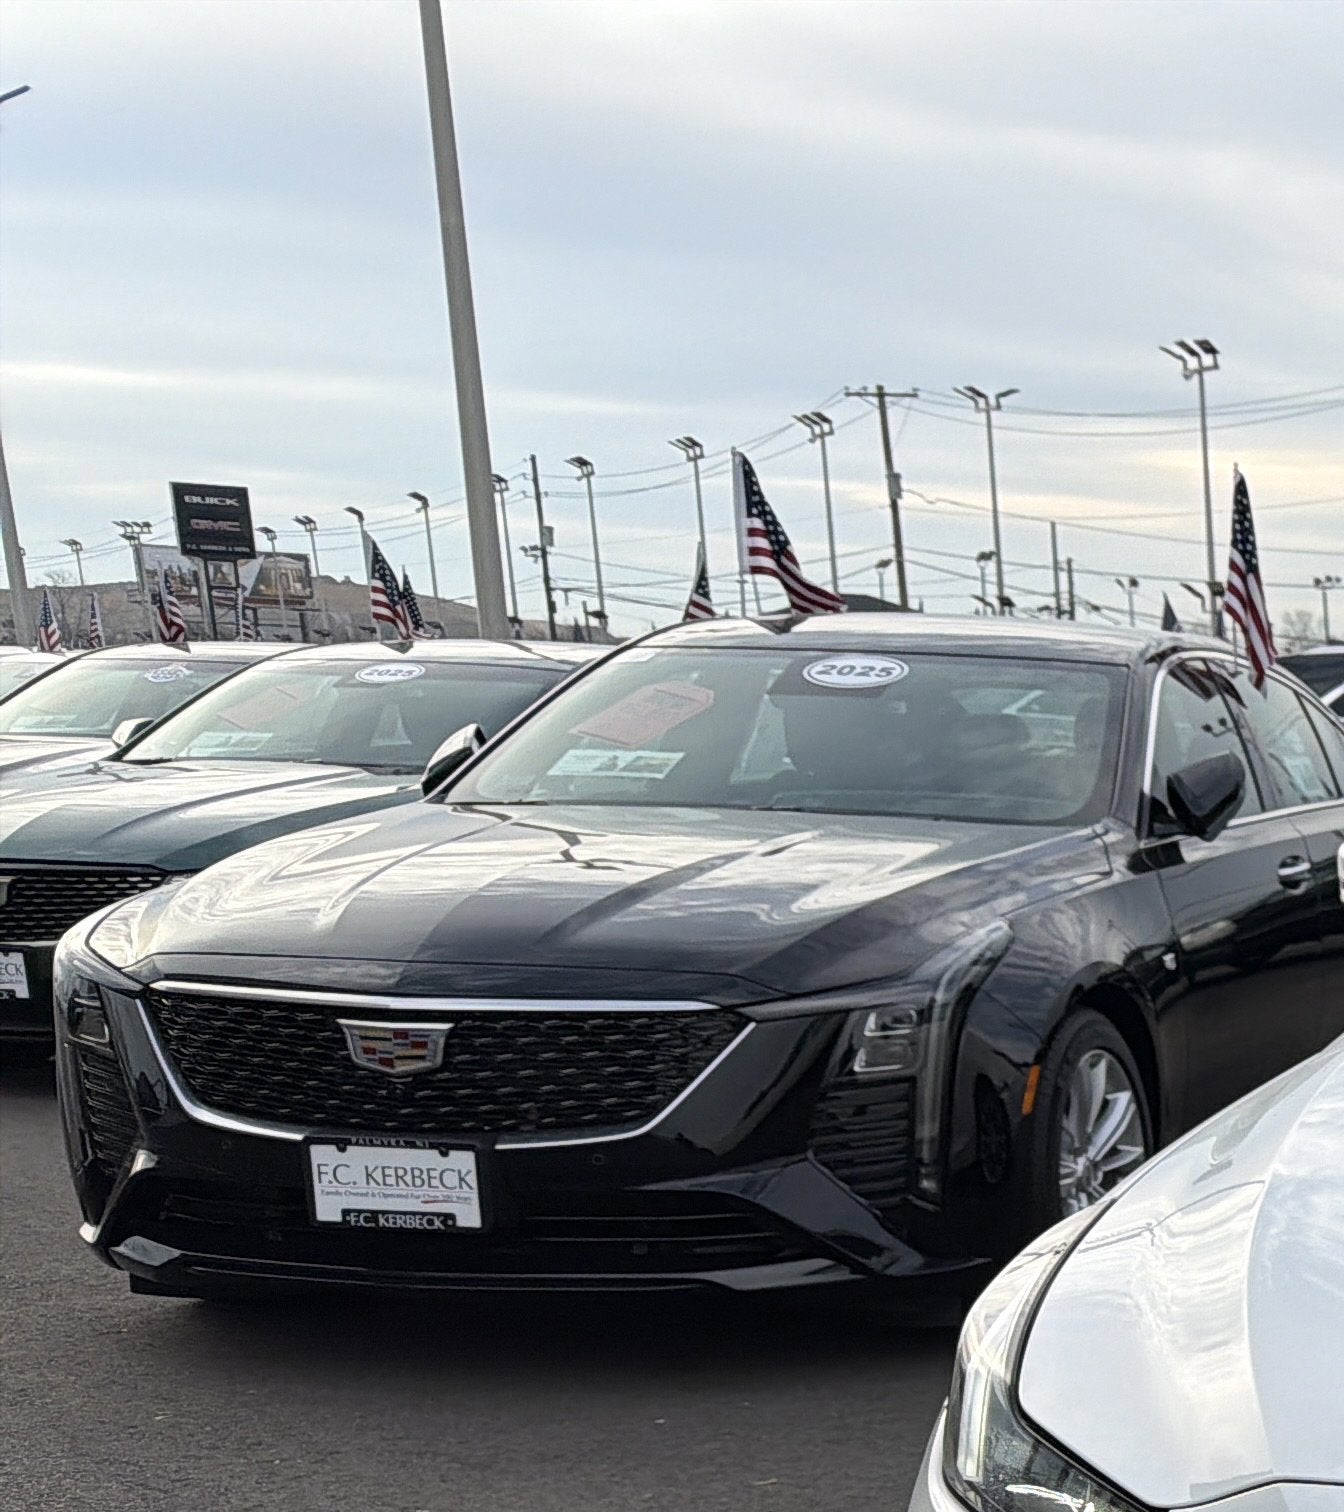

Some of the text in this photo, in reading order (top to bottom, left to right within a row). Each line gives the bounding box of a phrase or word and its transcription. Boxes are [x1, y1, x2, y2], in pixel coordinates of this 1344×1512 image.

[184, 495, 240, 506] BUICK
[190, 518, 241, 531] GMC
[367, 667, 416, 678] 2025
[816, 664, 896, 678] 2025
[316, 1163, 474, 1190] F.C. KERBECK
[351, 1213, 446, 1230] F.C. KERBECK
